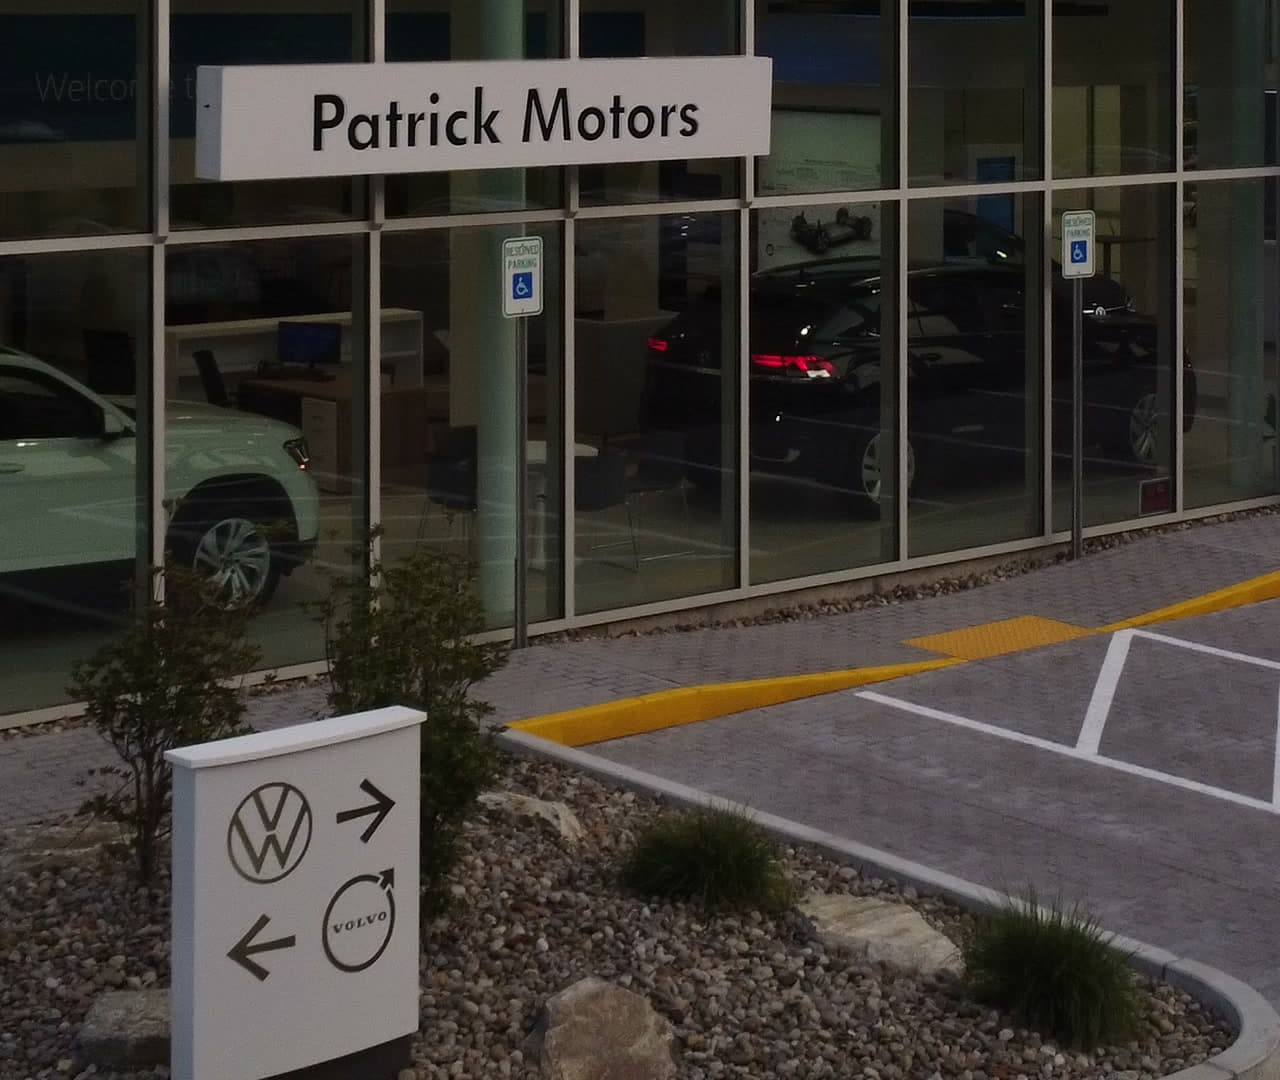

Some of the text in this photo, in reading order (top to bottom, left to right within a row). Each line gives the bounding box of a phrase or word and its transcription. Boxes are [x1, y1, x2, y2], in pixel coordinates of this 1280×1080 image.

[313, 86, 699, 151] Patrick Motors
[507, 257, 538, 270] PARKING
[333, 911, 388, 934] VOLVO
